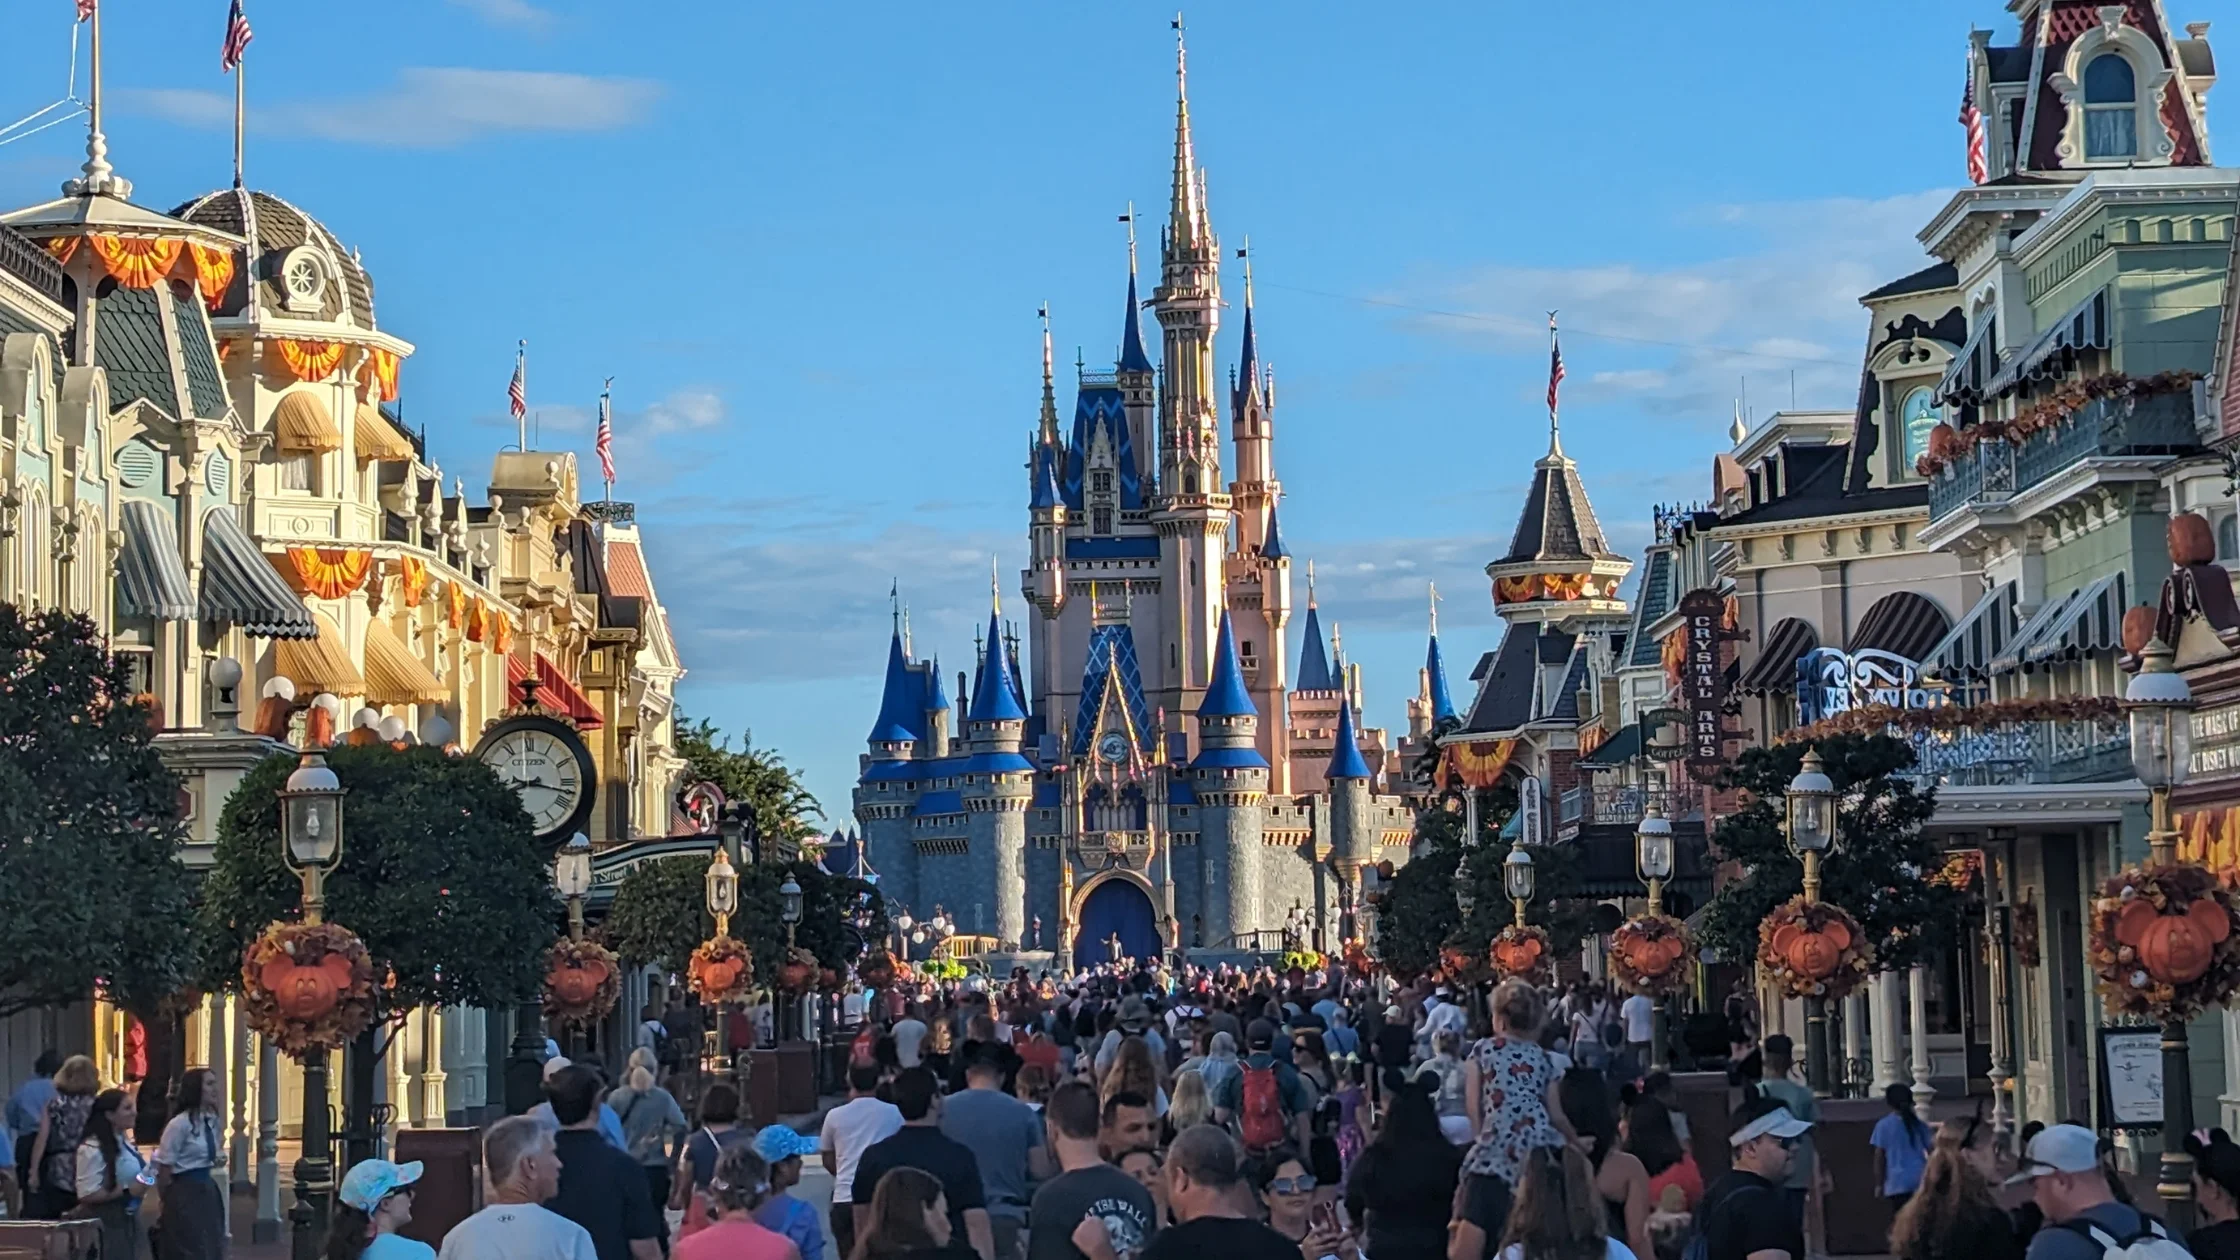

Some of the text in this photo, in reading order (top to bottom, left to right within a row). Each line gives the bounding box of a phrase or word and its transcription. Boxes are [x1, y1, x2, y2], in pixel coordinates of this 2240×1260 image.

[1694, 616, 1716, 757] CRYSTAL ARTS
[1651, 748, 1685, 759] COFFEE
[599, 866, 627, 883] Street
